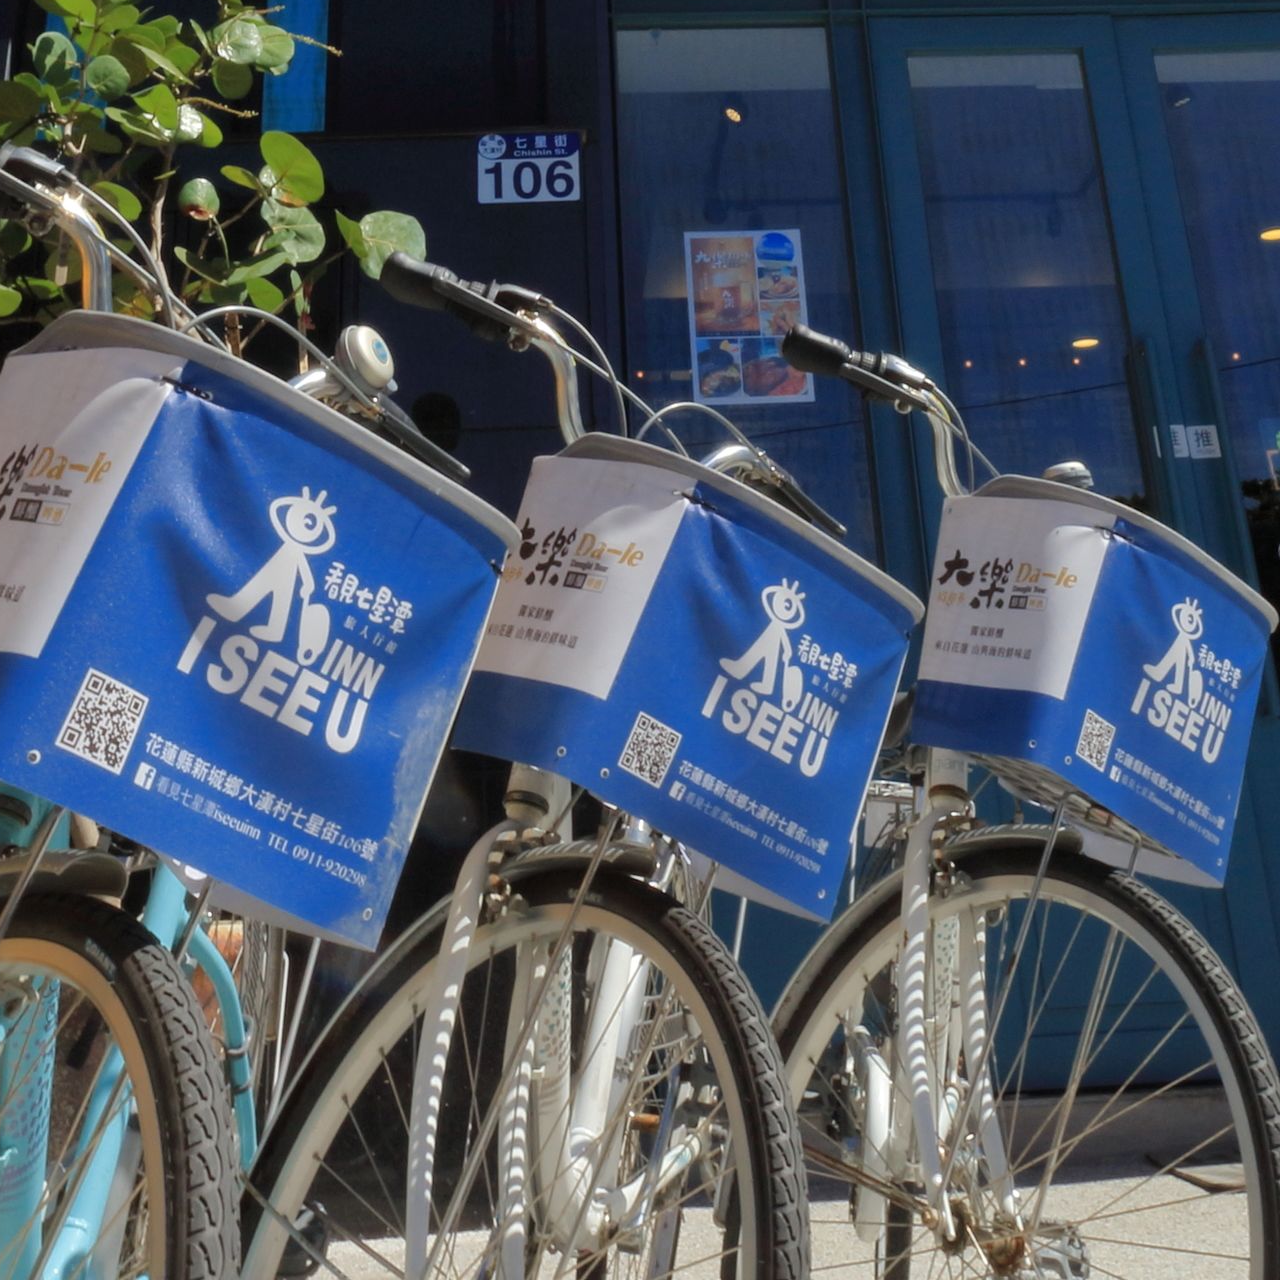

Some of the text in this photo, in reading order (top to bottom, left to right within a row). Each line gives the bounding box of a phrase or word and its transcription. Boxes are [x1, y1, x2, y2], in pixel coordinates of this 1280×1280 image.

[484, 160, 575, 199] 106
[1015, 561, 1079, 588] Da-le
[176, 615, 369, 754] I SEE U
[320, 638, 386, 700] INN
[701, 674, 829, 778] I SEE U
[797, 691, 840, 738] INN
[1130, 678, 1151, 715] I
[1147, 689, 1207, 753] SEE
[1202, 723, 1225, 764] U
[1199, 691, 1232, 732] INN
[268, 832, 289, 856] TEL
[292, 843, 369, 889] 0911-920298
